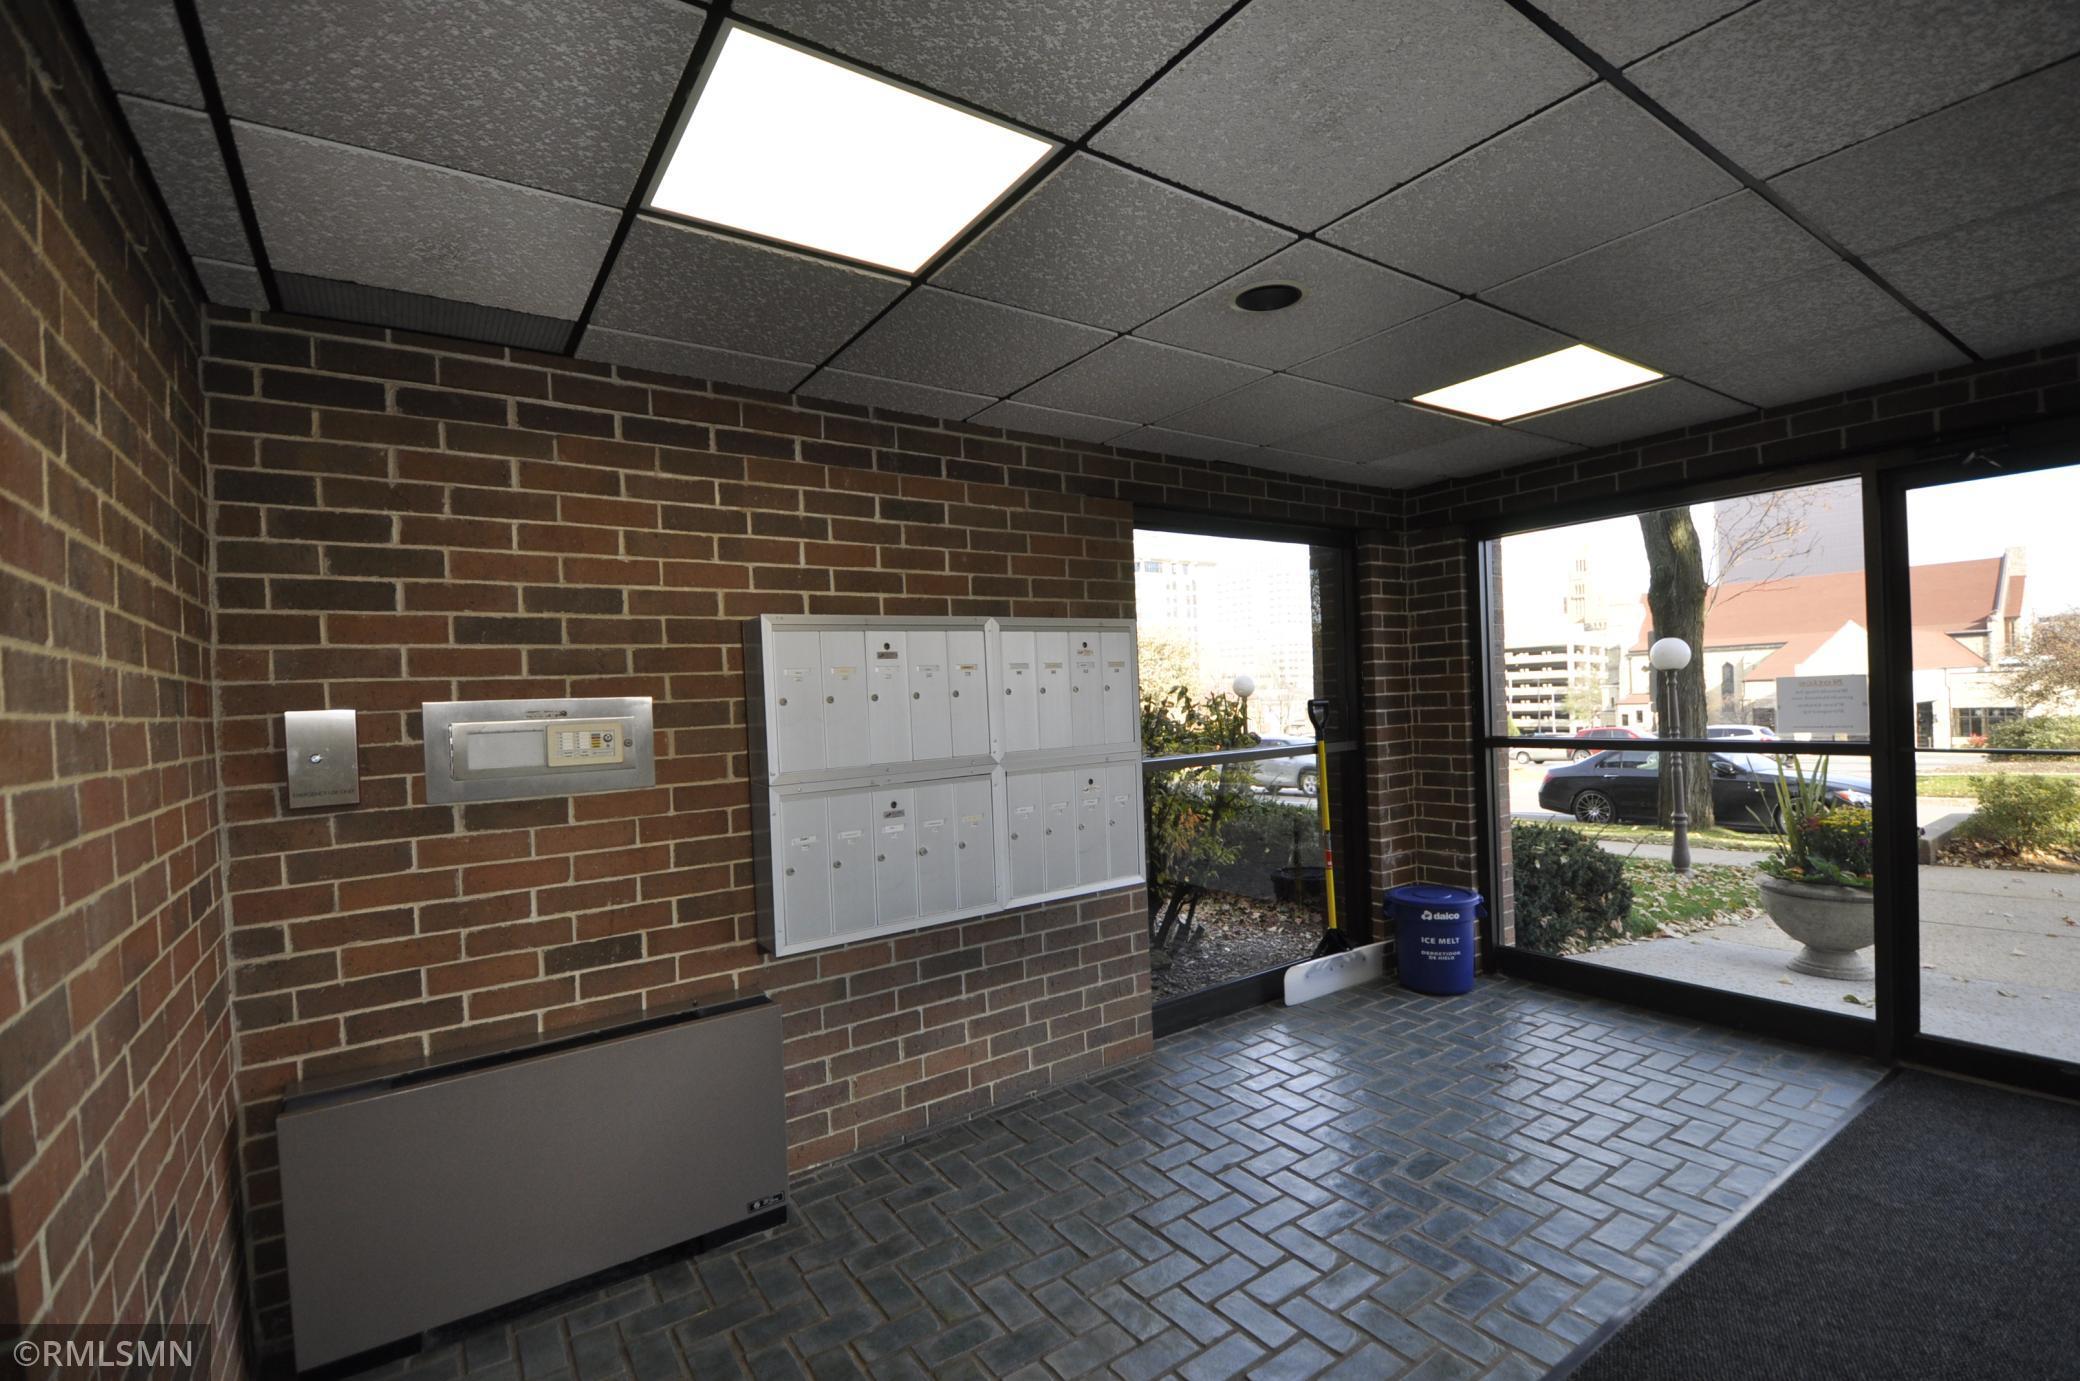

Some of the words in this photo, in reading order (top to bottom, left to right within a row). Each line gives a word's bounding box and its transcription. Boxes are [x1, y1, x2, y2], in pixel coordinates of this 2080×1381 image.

[1433, 912, 1460, 920] dalco
[1421, 936, 1436, 945] ICE
[1438, 937, 1460, 945] MELT
